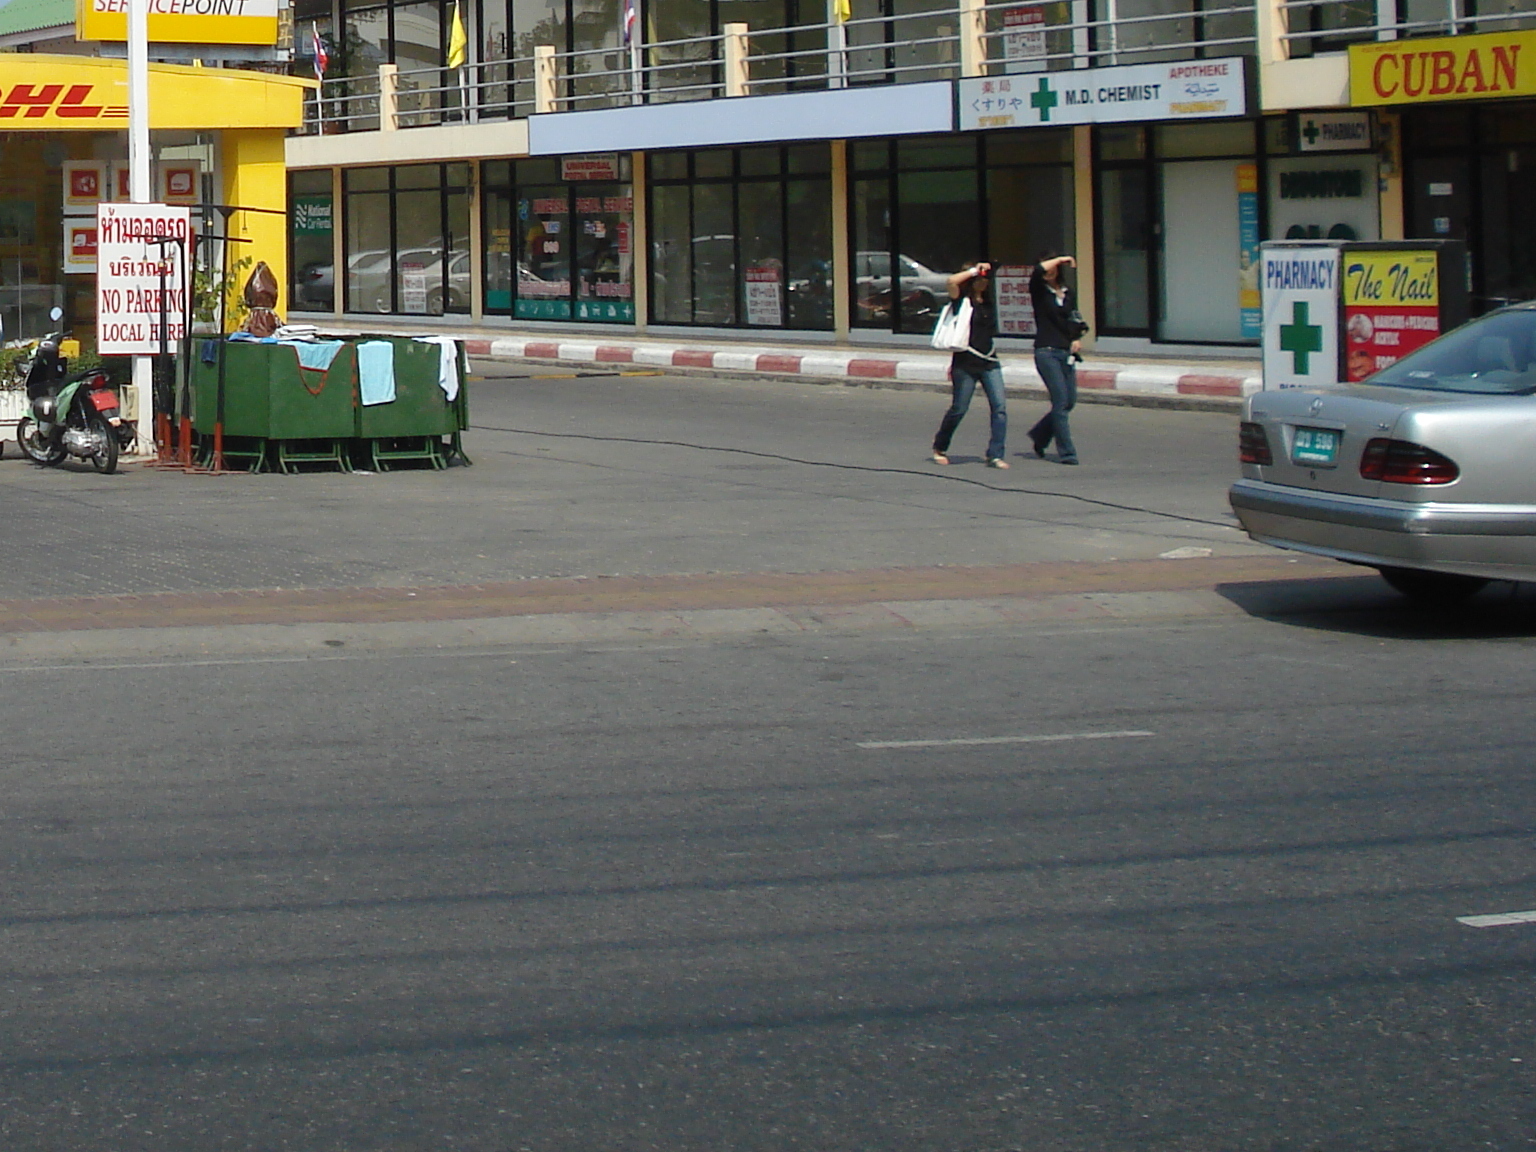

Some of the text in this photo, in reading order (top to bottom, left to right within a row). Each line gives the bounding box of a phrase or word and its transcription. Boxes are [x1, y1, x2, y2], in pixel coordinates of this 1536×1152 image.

[1169, 63, 1229, 80] APOTHEKE
[1373, 44, 1522, 99] CUBAN
[971, 98, 1023, 112] くすりや
[1065, 84, 1162, 106] M.D. CHEMIST
[1322, 122, 1365, 141] PHARMACY
[307, 204, 331, 217] National
[101, 207, 186, 244] ห้ามจอดรถ
[307, 218, 332, 229] Car Rental
[1267, 259, 1335, 290] PHARMACY
[1347, 263, 1436, 301] The Nail
[101, 289, 121, 314] NO
[102, 323, 185, 342] LOCAL HRE
